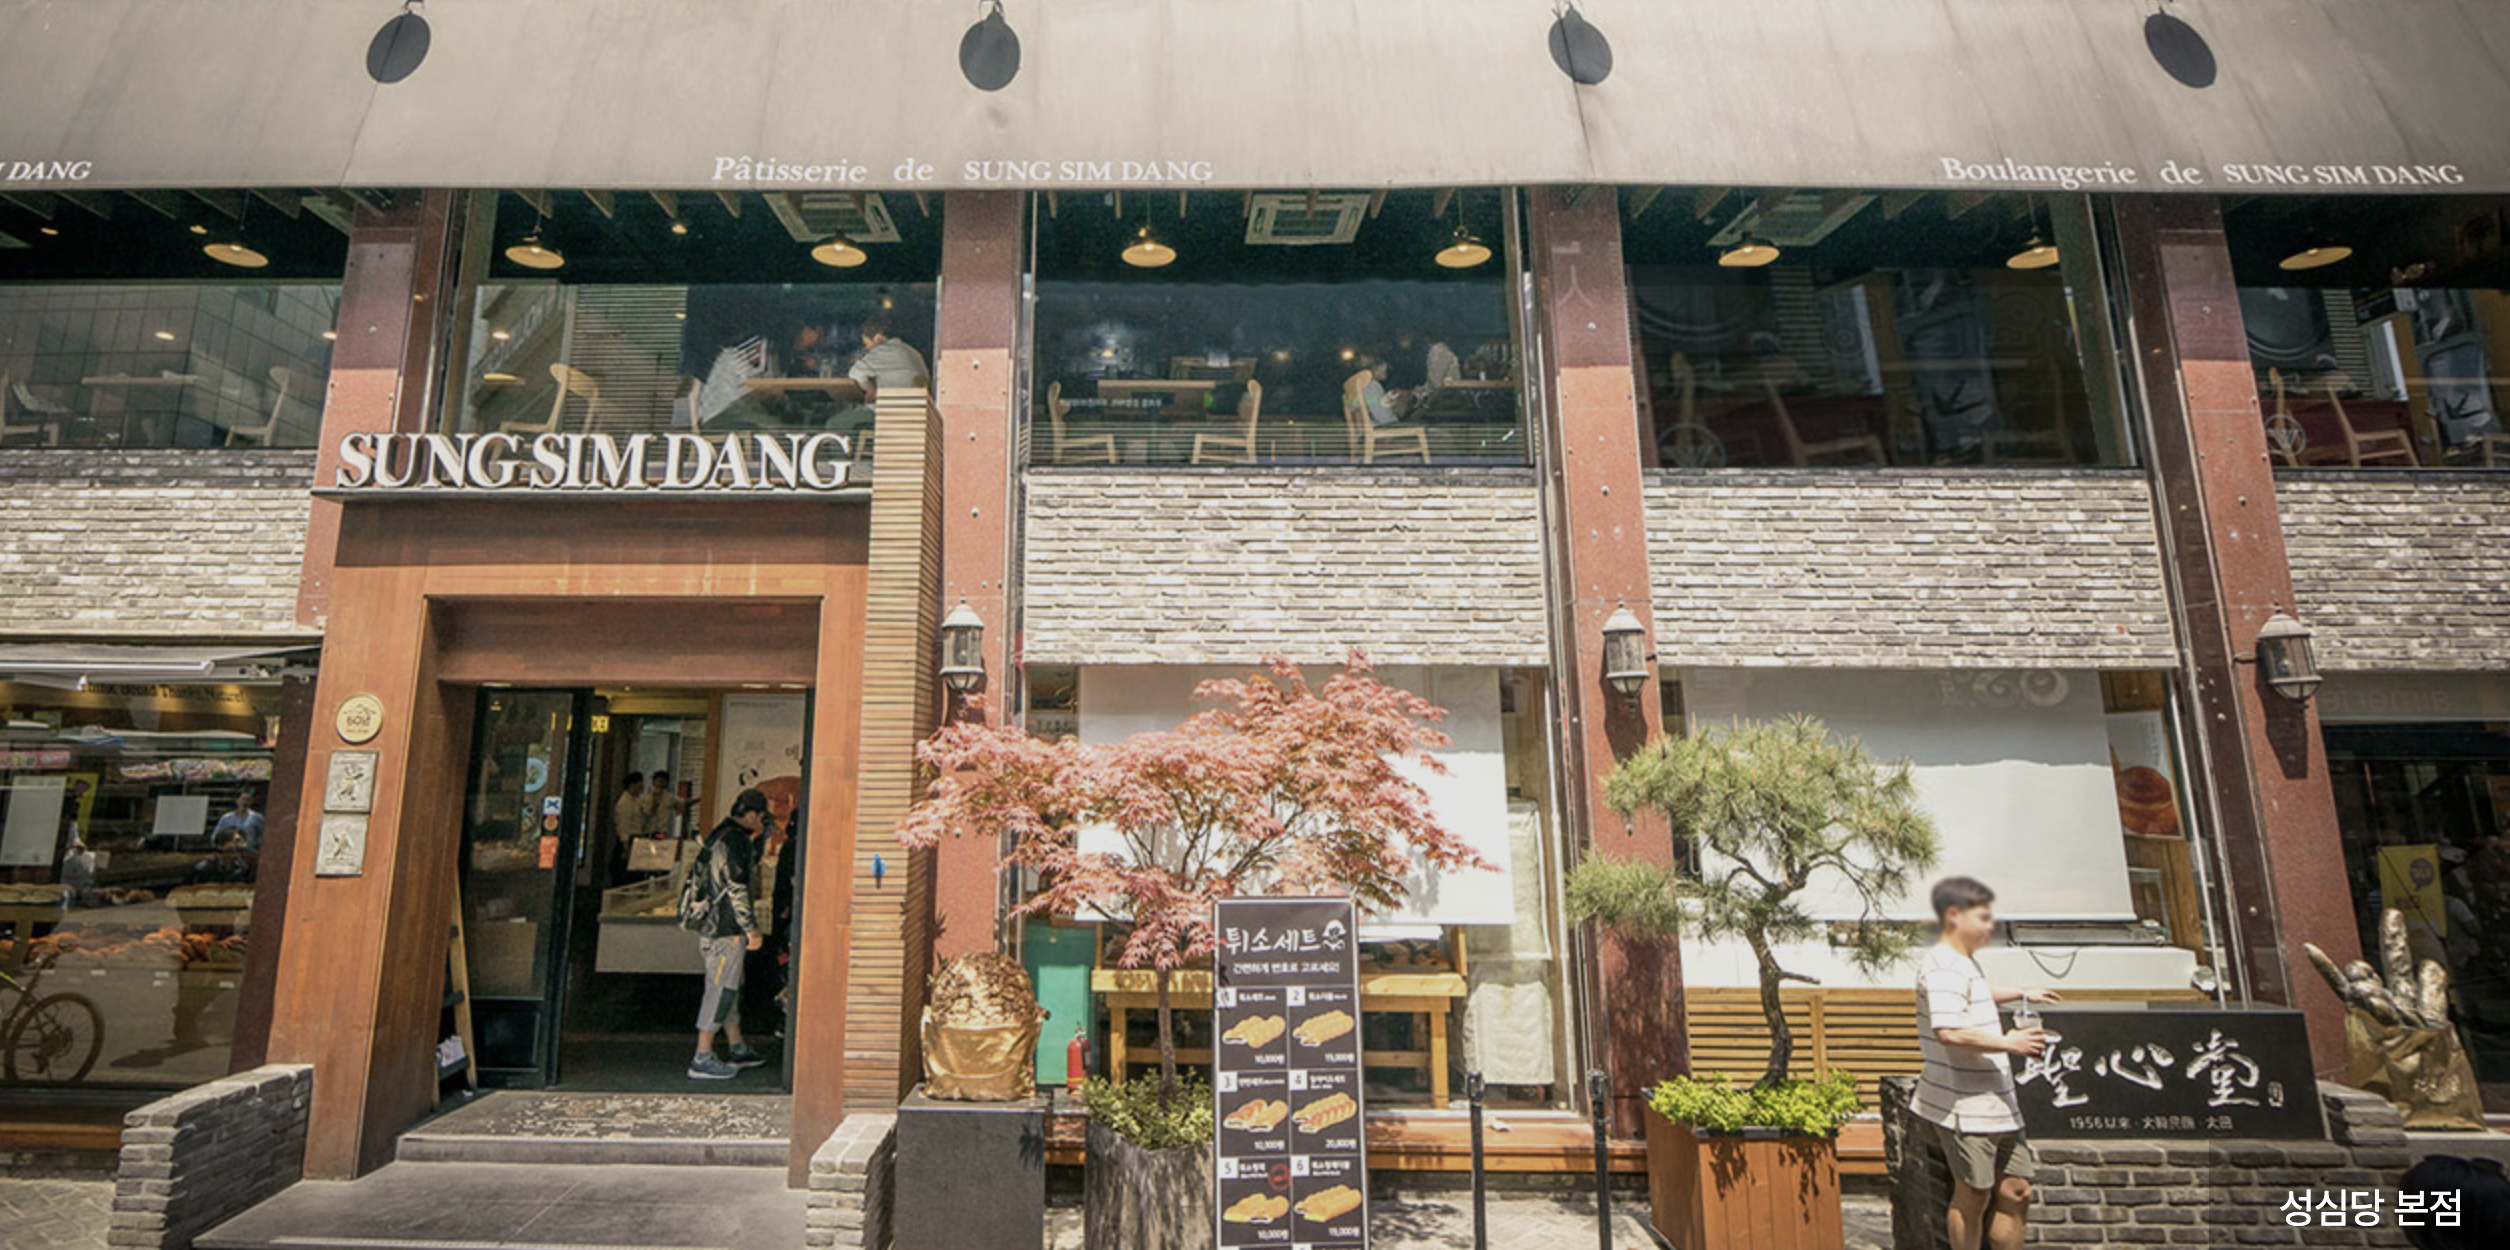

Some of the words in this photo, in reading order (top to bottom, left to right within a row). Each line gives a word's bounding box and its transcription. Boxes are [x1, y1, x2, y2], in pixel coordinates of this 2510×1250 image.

[7, 161, 92, 180] DANG
[711, 156, 867, 182] Pâtisserie
[893, 157, 934, 181] de
[964, 160, 1052, 181] SUNG
[1059, 160, 1112, 181] SIM
[1122, 160, 1213, 181] DANG
[1940, 157, 2138, 190] Boulangerie
[2160, 160, 2204, 185] de
[2223, 163, 2310, 185] SUNG
[2313, 164, 2369, 185] SIM
[2372, 164, 2464, 185] DANG
[336, 432, 521, 490] SUNG
[529, 432, 653, 490] SIM
[658, 432, 852, 490] DANG
[1225, 927, 1321, 955] 튀소세트
[1293, 989, 1300, 1001] 2
[2015, 1028, 2260, 1107] 聖心堂
[1224, 1076, 1231, 1088] 3
[1224, 1162, 1231, 1174] 5
[1296, 1160, 1303, 1171] 6
